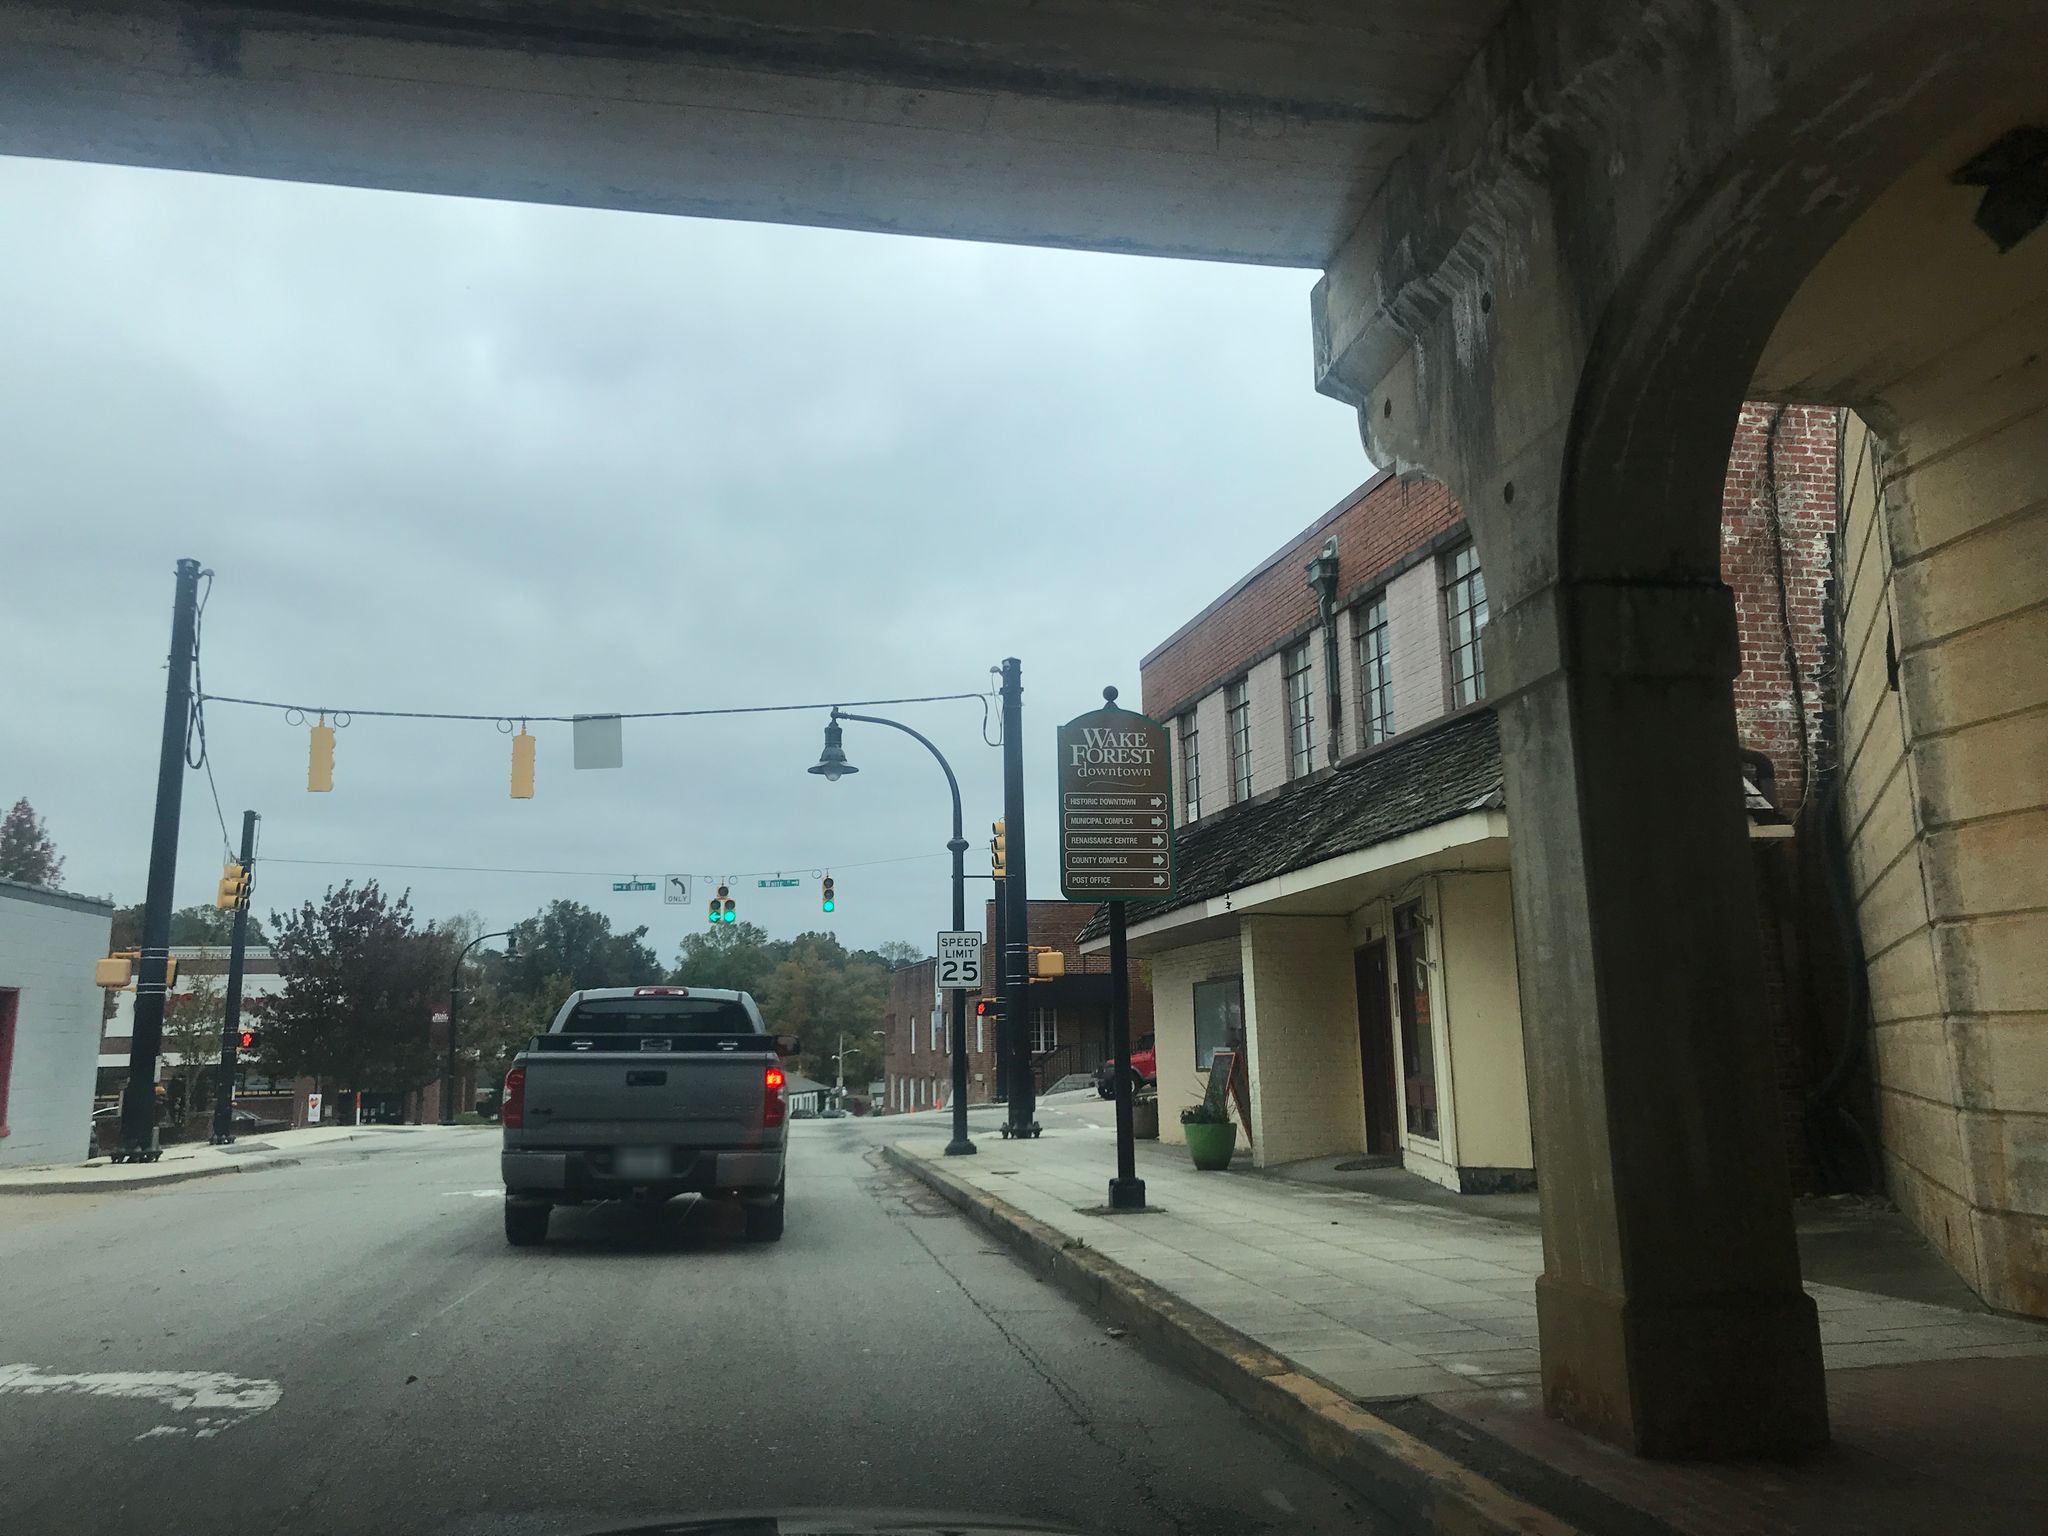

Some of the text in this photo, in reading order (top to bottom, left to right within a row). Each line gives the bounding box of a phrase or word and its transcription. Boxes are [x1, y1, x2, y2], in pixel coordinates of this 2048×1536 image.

[1082, 728, 1149, 749] WAKE
[1070, 745, 1155, 766] FOREST
[1077, 762, 1151, 778] downtown
[1100, 798, 1136, 806] DOWNTOWN
[1070, 817, 1134, 825] MUNICIPAL COMPLEX
[1071, 837, 1138, 845] RENAISSANCE CENTRE
[1071, 856, 1128, 864] COUNTY COMPLEX
[1072, 876, 1111, 884] POST OFFICE
[667, 895, 688, 903] ONLY
[941, 938, 979, 947] SPEED
[945, 949, 974, 959] LIMIT
[942, 960, 978, 982] 25
